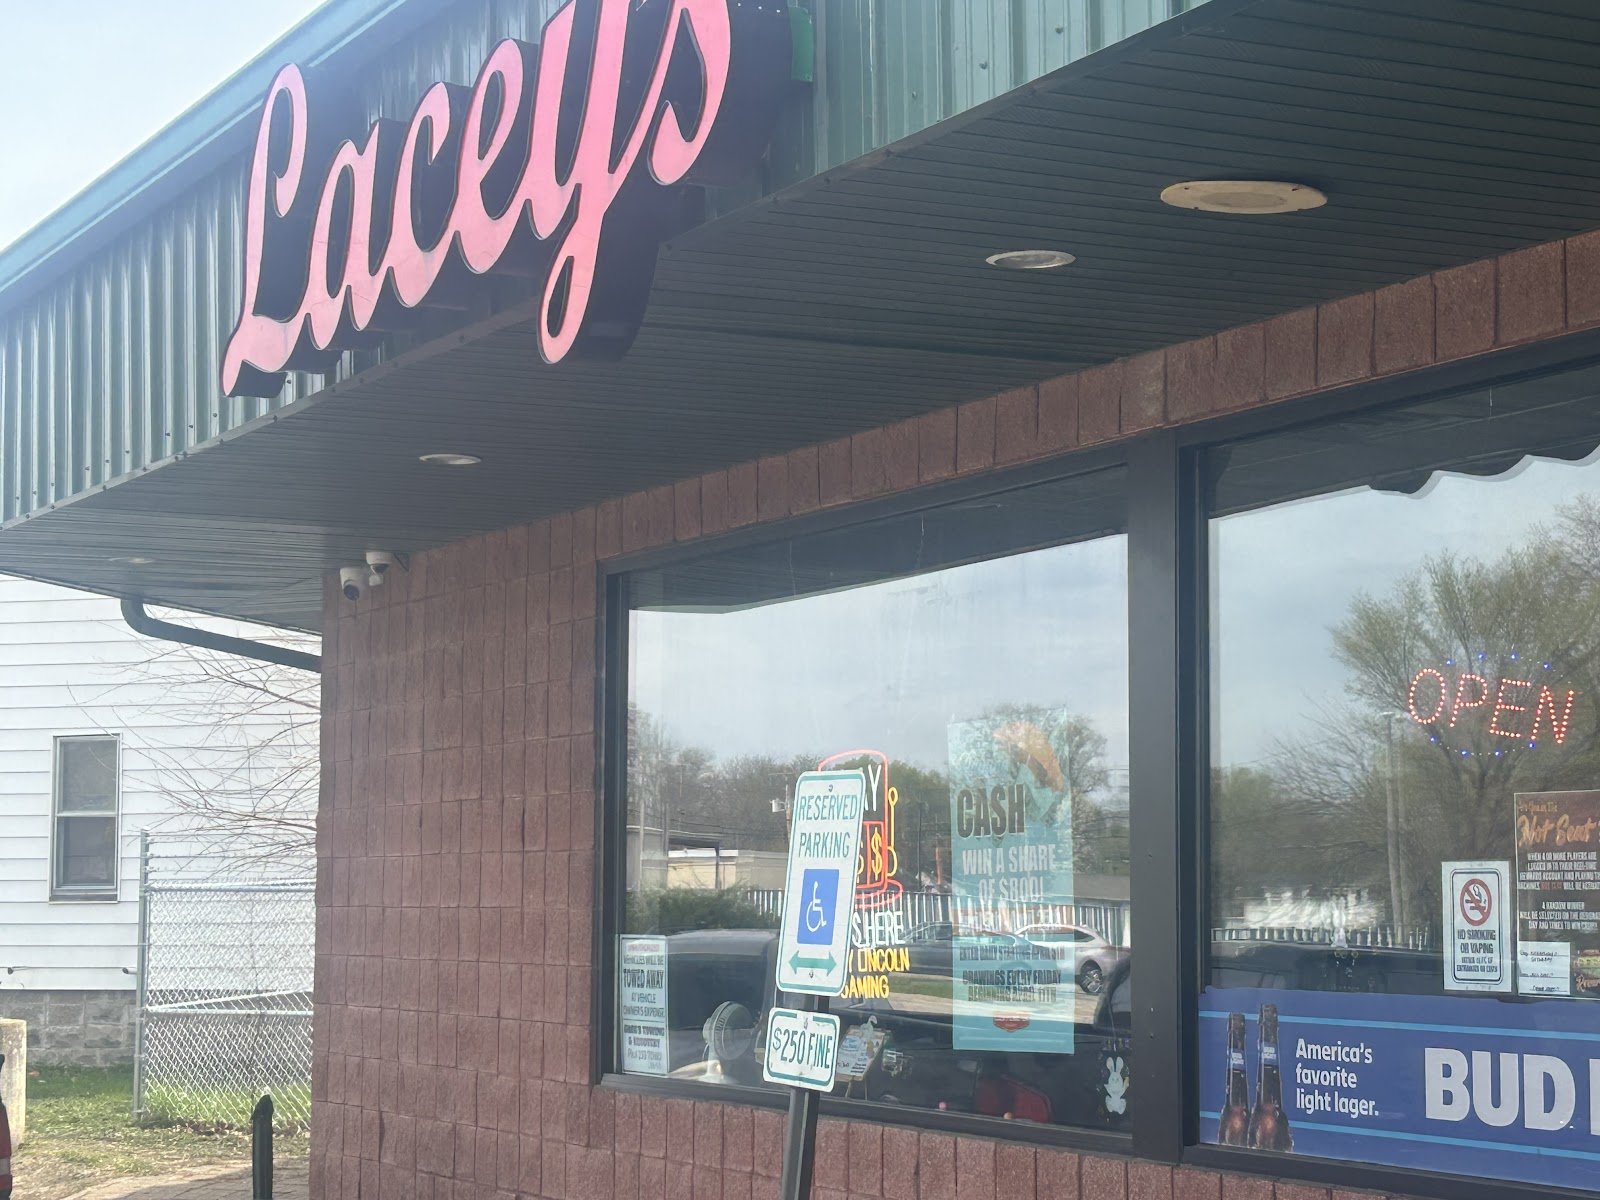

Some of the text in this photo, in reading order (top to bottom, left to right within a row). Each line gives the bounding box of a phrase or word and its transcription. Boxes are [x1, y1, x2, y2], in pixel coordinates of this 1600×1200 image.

[223, 0, 730, 397] Laceys
[1408, 668, 1575, 744] OPEN
[798, 794, 858, 821] RESERVED
[957, 784, 1025, 837] CASH
[1517, 813, 1597, 848] Hot Seat
[798, 831, 851, 858] PARKING
[962, 844, 1057, 877] WIN A SHARE
[979, 878, 996, 903] OF
[1457, 929, 1496, 940] NO SMOKING
[1460, 943, 1494, 953] OR VAPING
[624, 955, 646, 965] VEHICLES
[646, 955, 657, 965] WILL
[858, 947, 911, 973] LINCOLN
[623, 969, 664, 989] TOWED AWAY
[963, 969, 1062, 985] DRAWINGS EVERY FRIDAY
[638, 993, 656, 1003] VEHICLE
[644, 1007, 665, 1018] EXPENSE
[772, 1027, 806, 1064] $250
[807, 1032, 833, 1069] FINE
[1296, 1038, 1373, 1064] America's
[1295, 1062, 1357, 1089] favorite
[1425, 1047, 1577, 1131] BUD
[1296, 1088, 1379, 1119] light lager.
